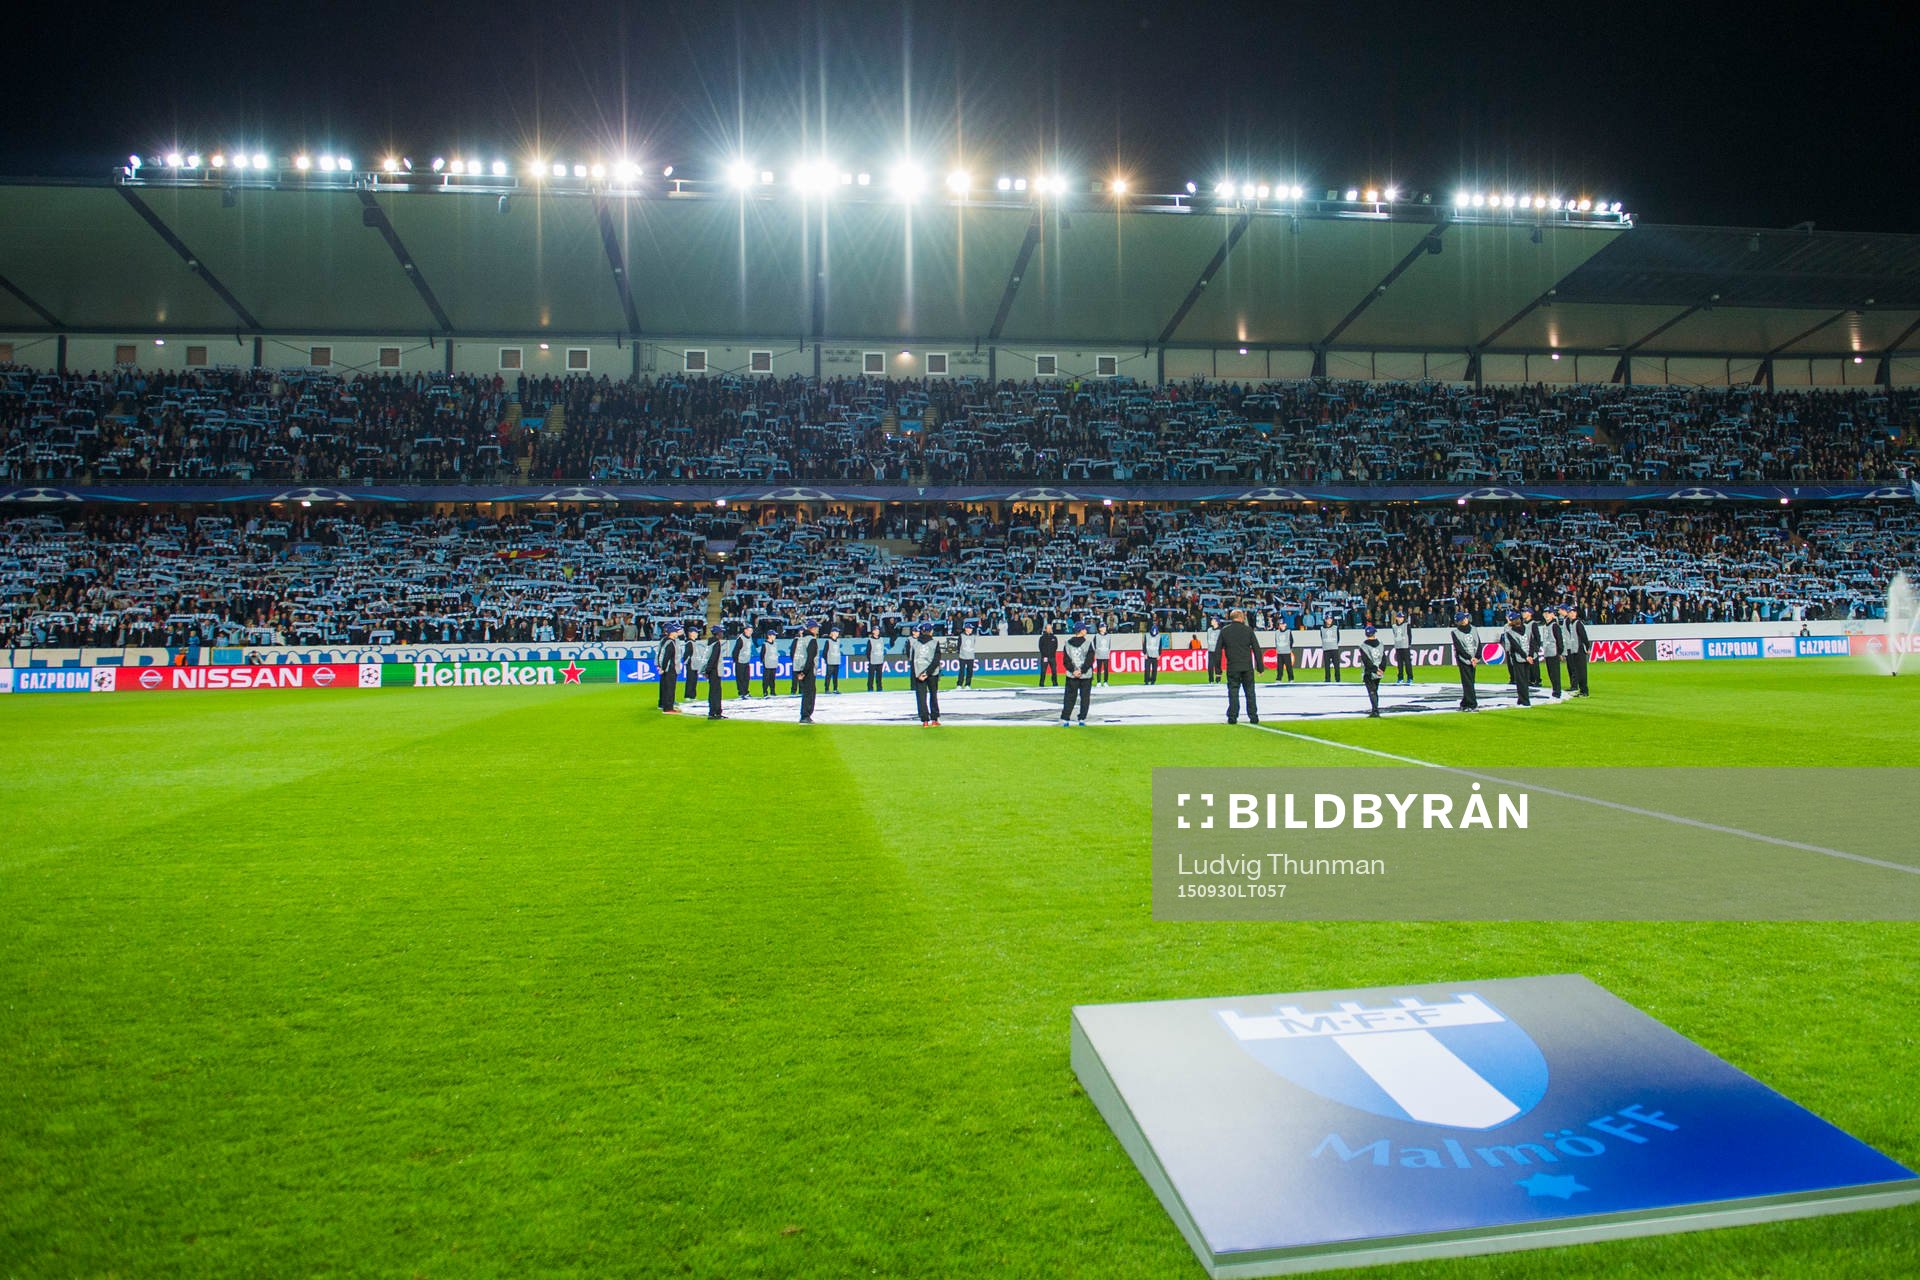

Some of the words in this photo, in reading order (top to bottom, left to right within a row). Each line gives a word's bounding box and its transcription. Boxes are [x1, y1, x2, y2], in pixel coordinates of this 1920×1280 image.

[1589, 640, 1645, 662] MAX
[1708, 641, 1758, 656] GAZPROM
[1799, 640, 1848, 655] GAZPROM
[413, 662, 556, 687] Heineken
[852, 660, 891, 673] UEA
[894, 659, 980, 672] CHPIOS
[984, 657, 1039, 672] LEAGUE
[20, 672, 89, 690] GAZPROM
[173, 668, 303, 688] NISSAN
[1312, 1129, 1606, 1169] Malmö
[1587, 1103, 1680, 1145] FF
